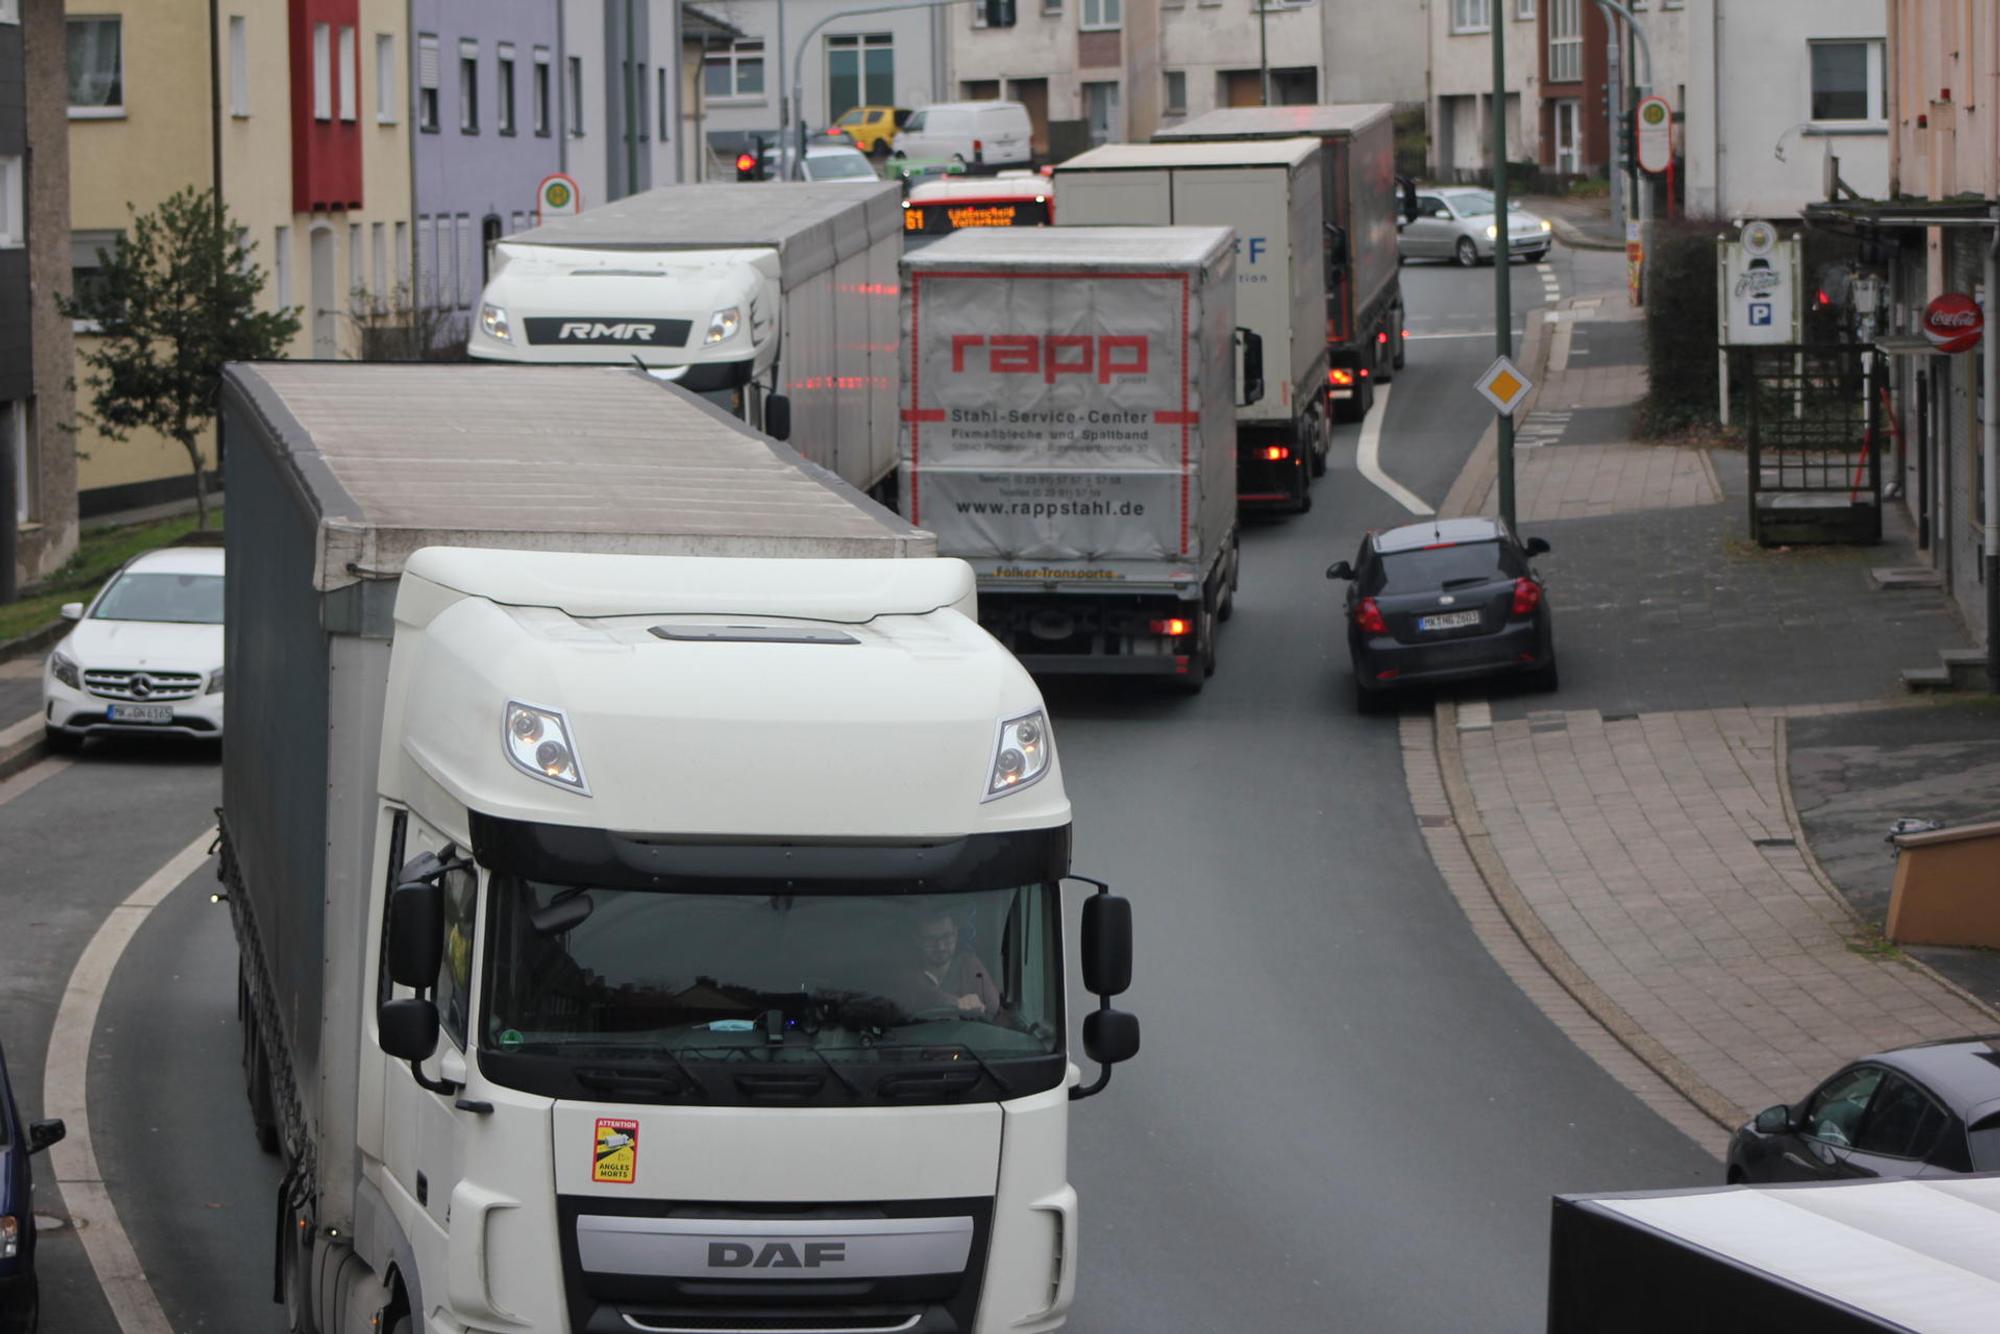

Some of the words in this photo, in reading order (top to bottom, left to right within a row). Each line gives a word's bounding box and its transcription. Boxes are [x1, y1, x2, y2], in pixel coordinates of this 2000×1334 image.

[558, 322, 656, 340] RMR
[952, 334, 1148, 384] rapp
[1050, 430, 1075, 440] und
[956, 500, 1145, 518] www.rappstahl.de
[599, 1120, 637, 1128] ATTENTION
[600, 1163, 630, 1171] ANGLES
[600, 1170, 628, 1178] MORTS
[708, 1242, 845, 1267] DAF
